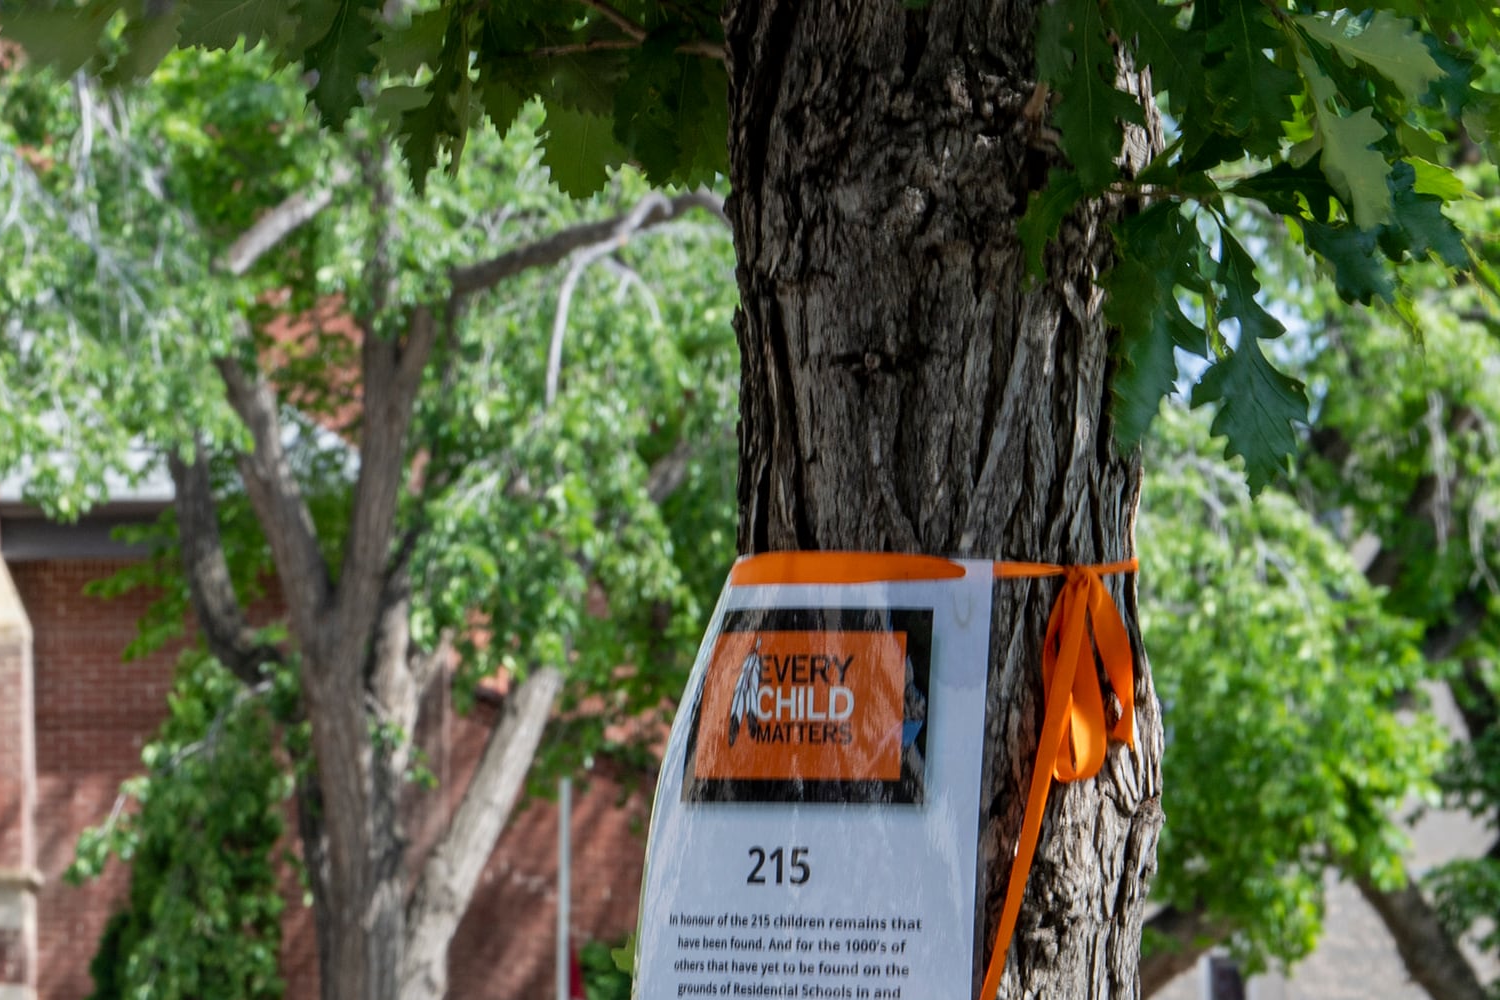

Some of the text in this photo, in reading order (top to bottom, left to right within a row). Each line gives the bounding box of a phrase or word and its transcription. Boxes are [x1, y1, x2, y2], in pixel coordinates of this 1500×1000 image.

[758, 654, 854, 685] EVERY
[756, 685, 855, 721] CHILD
[756, 721, 853, 745] MATTERS
[746, 845, 811, 886] 215
[669, 912, 923, 932] In honour of the 215 children remains that
[678, 935, 700, 948] have
[702, 936, 727, 949] been
[730, 936, 766, 950] found.
[768, 938, 792, 951] And
[796, 938, 814, 951] for
[818, 938, 841, 953] the
[891, 939, 908, 955] of
[674, 958, 910, 978] others that have yet to be found on the
[677, 981, 902, 1000] grounds of Residential Schools in and
